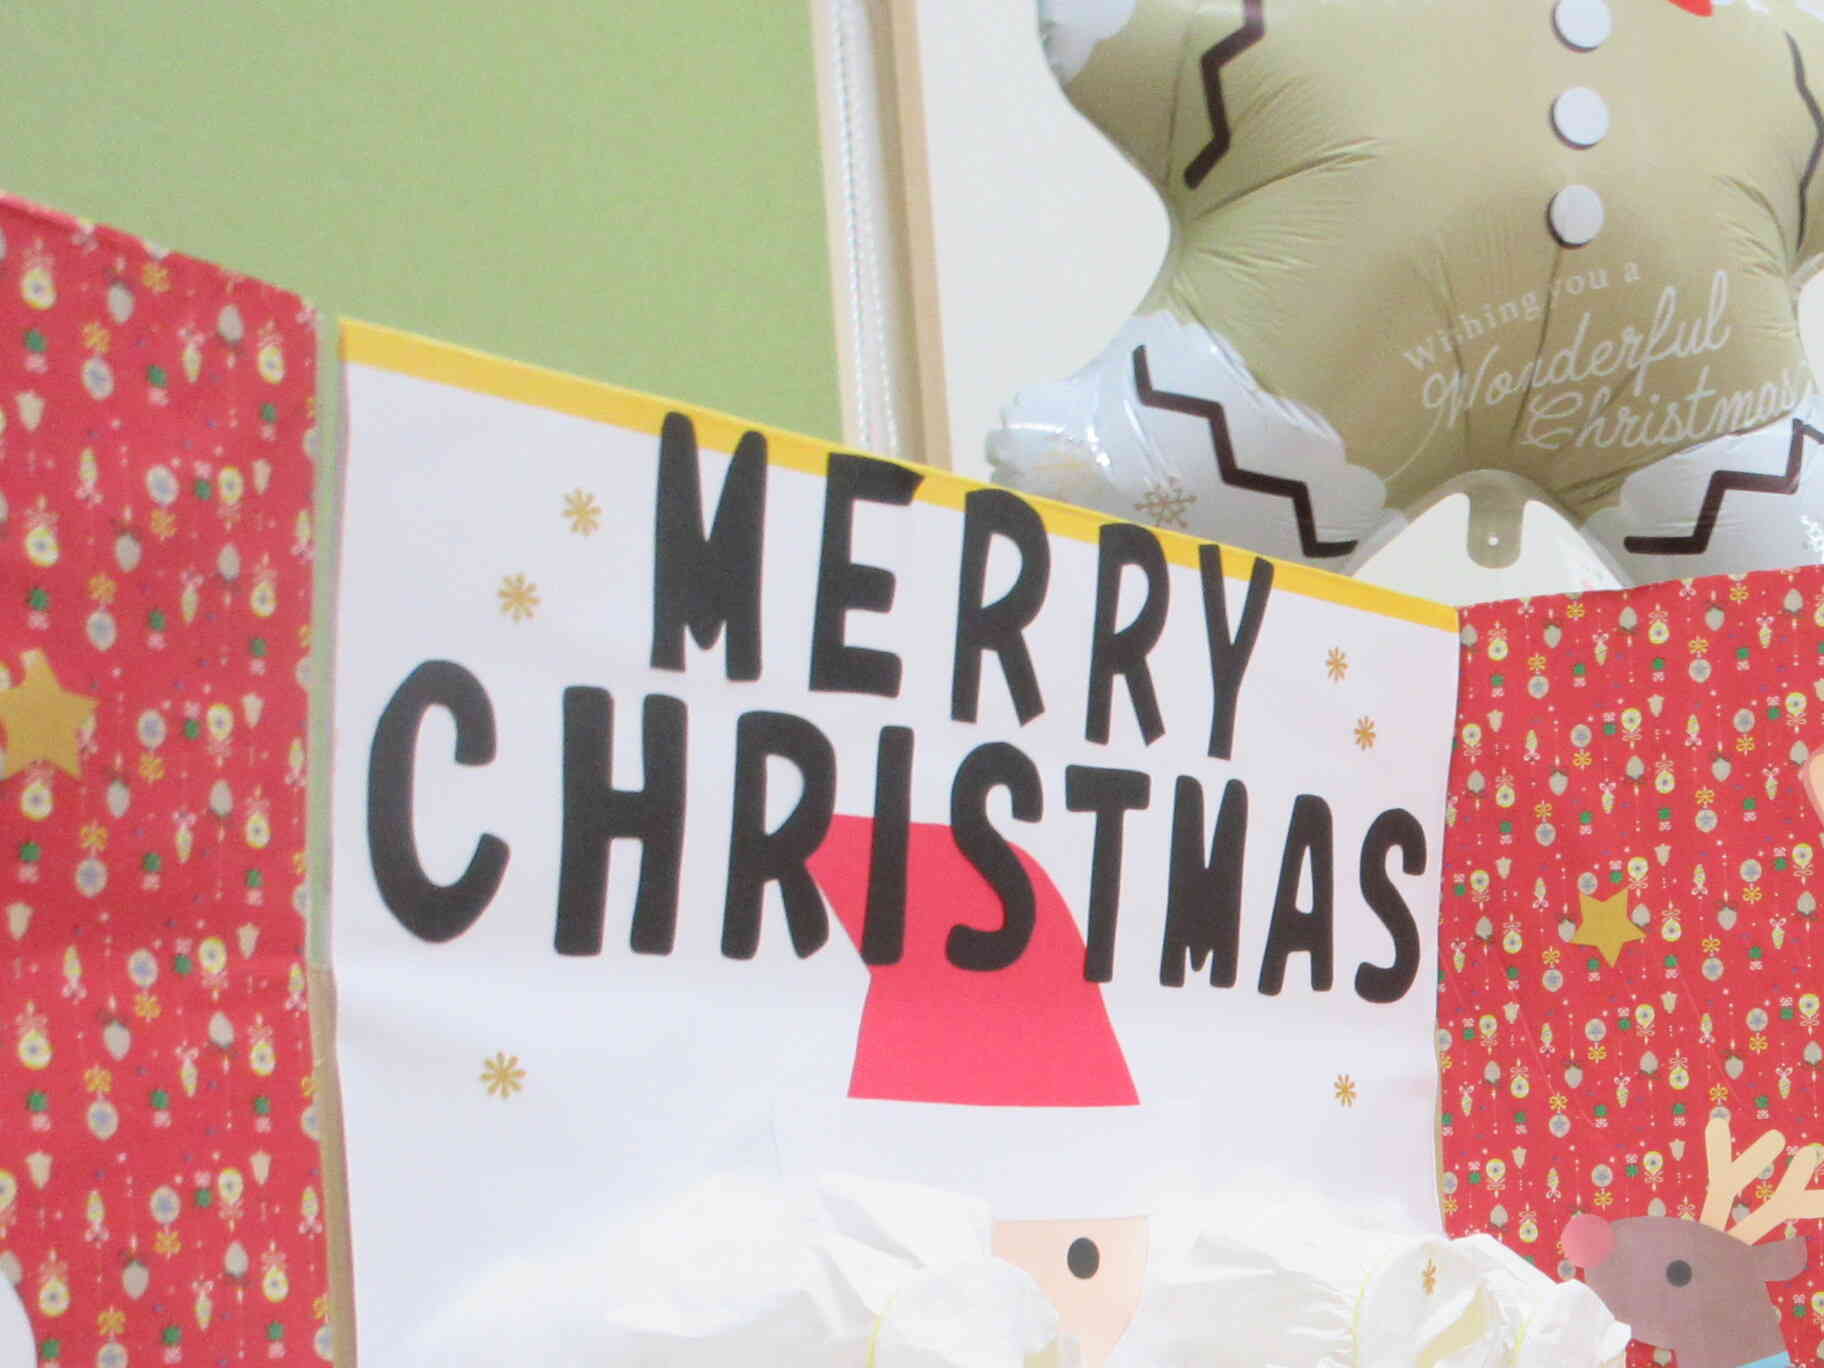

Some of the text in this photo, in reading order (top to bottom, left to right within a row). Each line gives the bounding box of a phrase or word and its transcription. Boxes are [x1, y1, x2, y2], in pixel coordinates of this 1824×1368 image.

[1402, 290, 1541, 370] Wihing
[1625, 261, 1641, 283] a
[1422, 271, 1731, 430] Wonderful
[1520, 360, 1816, 449] Christmas
[650, 411, 1273, 760] MERRY
[367, 659, 1427, 1003] CHRISTMAS
